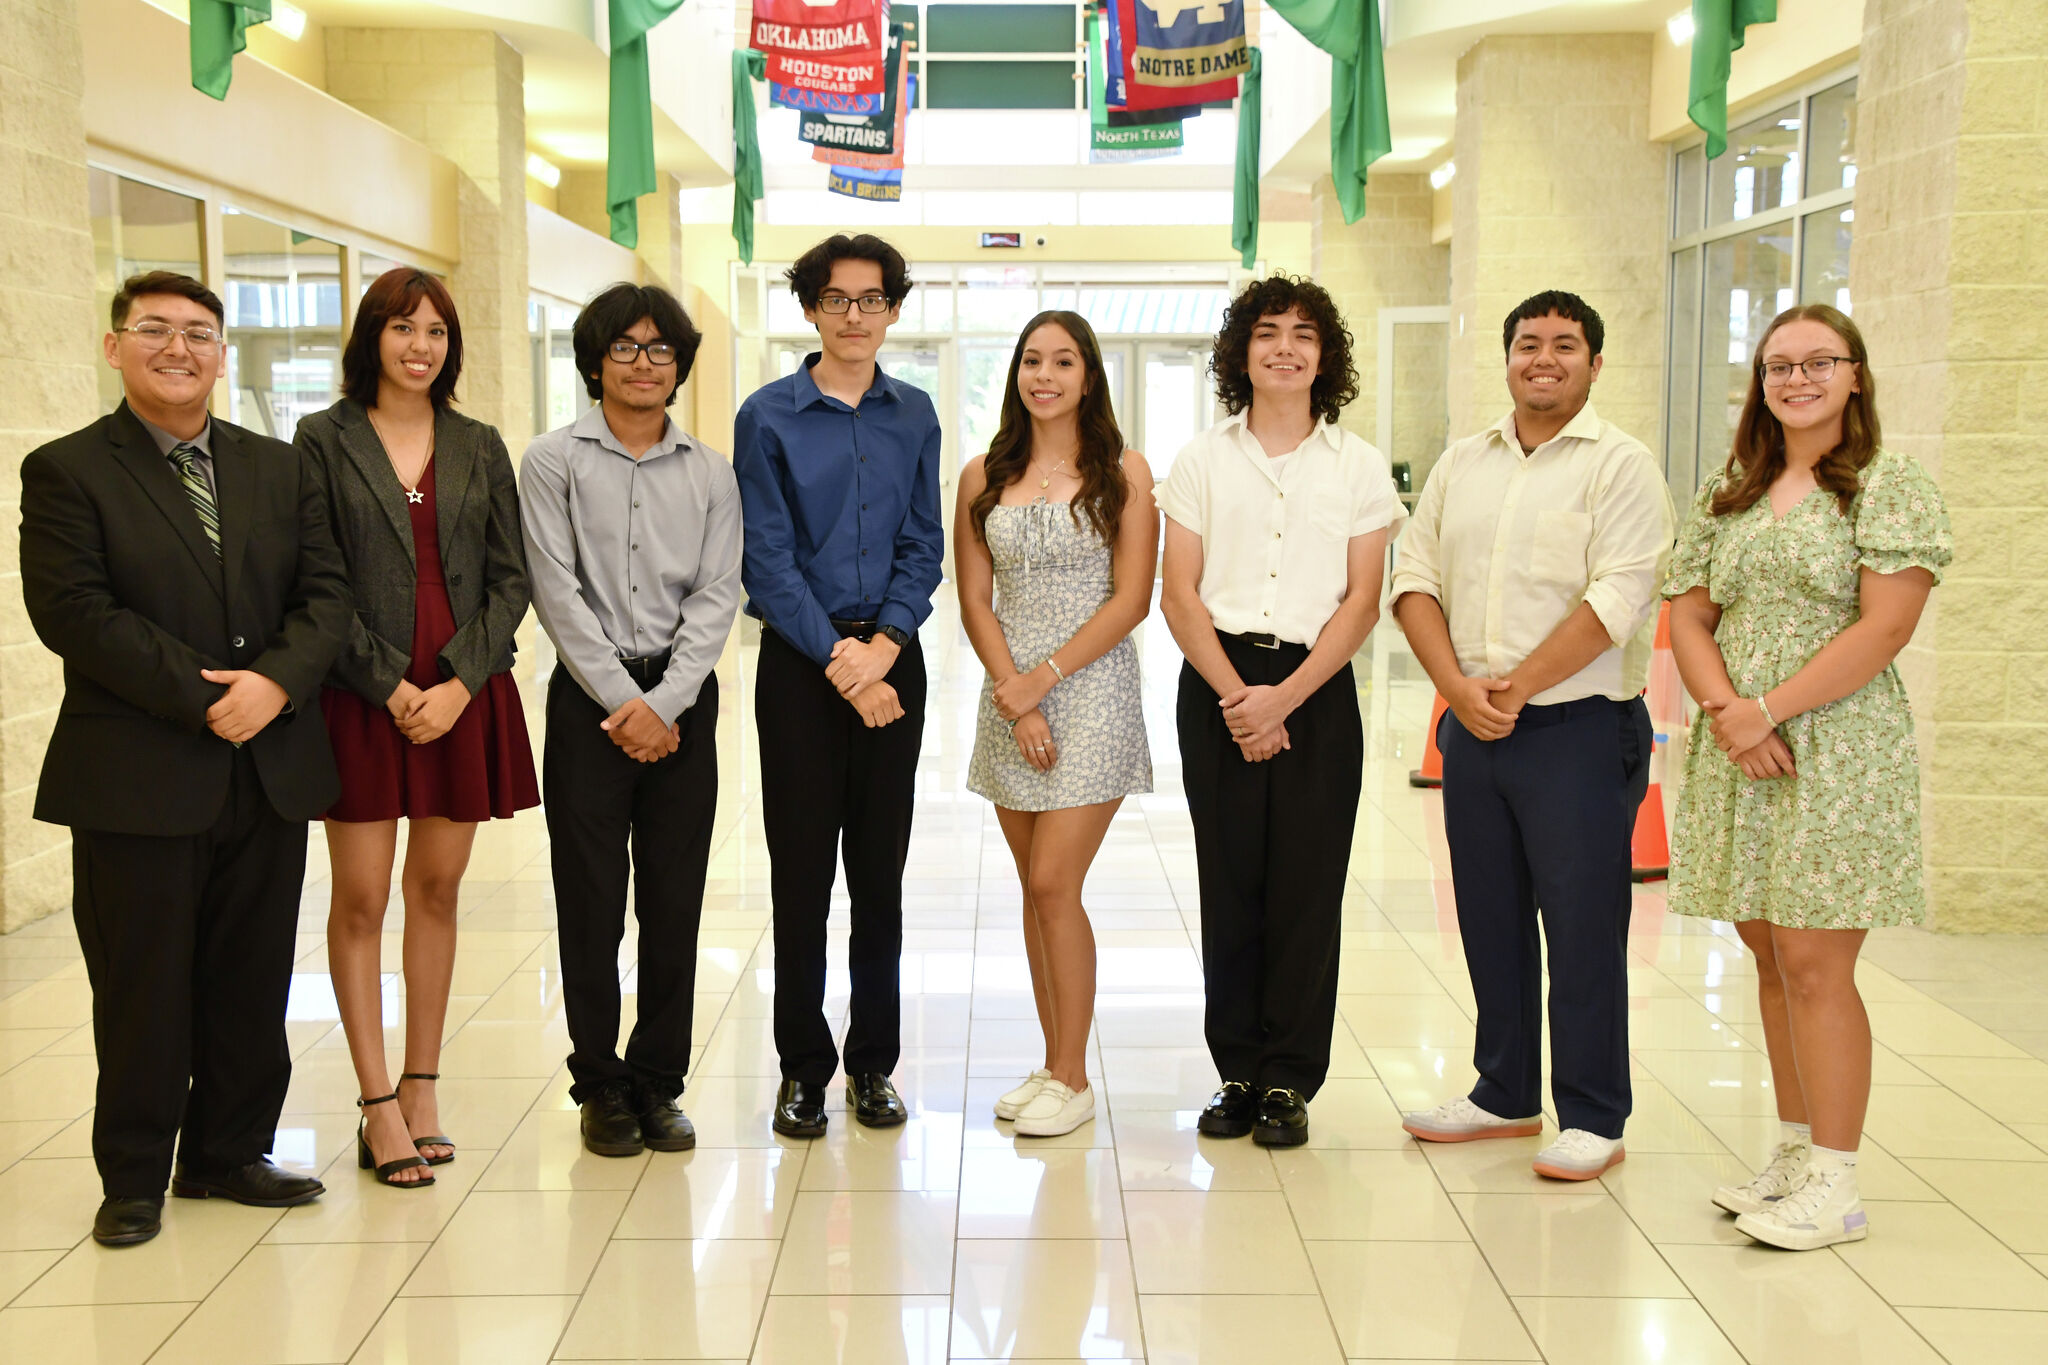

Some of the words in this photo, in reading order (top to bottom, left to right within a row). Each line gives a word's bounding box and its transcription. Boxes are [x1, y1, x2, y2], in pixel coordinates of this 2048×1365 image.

[756, 22, 869, 51] OKLAHOMA
[780, 56, 874, 81] HOUSTON
[1139, 56, 1195, 76] NOTRE
[1201, 47, 1249, 74] DAME
[794, 76, 856, 93] COUGARS
[778, 86, 873, 112] KANSAS
[803, 122, 887, 148] SPARTANS
[1095, 130, 1139, 143] NORTH
[1141, 128, 1181, 140] TEXAS
[856, 182, 901, 199] BRUINS
